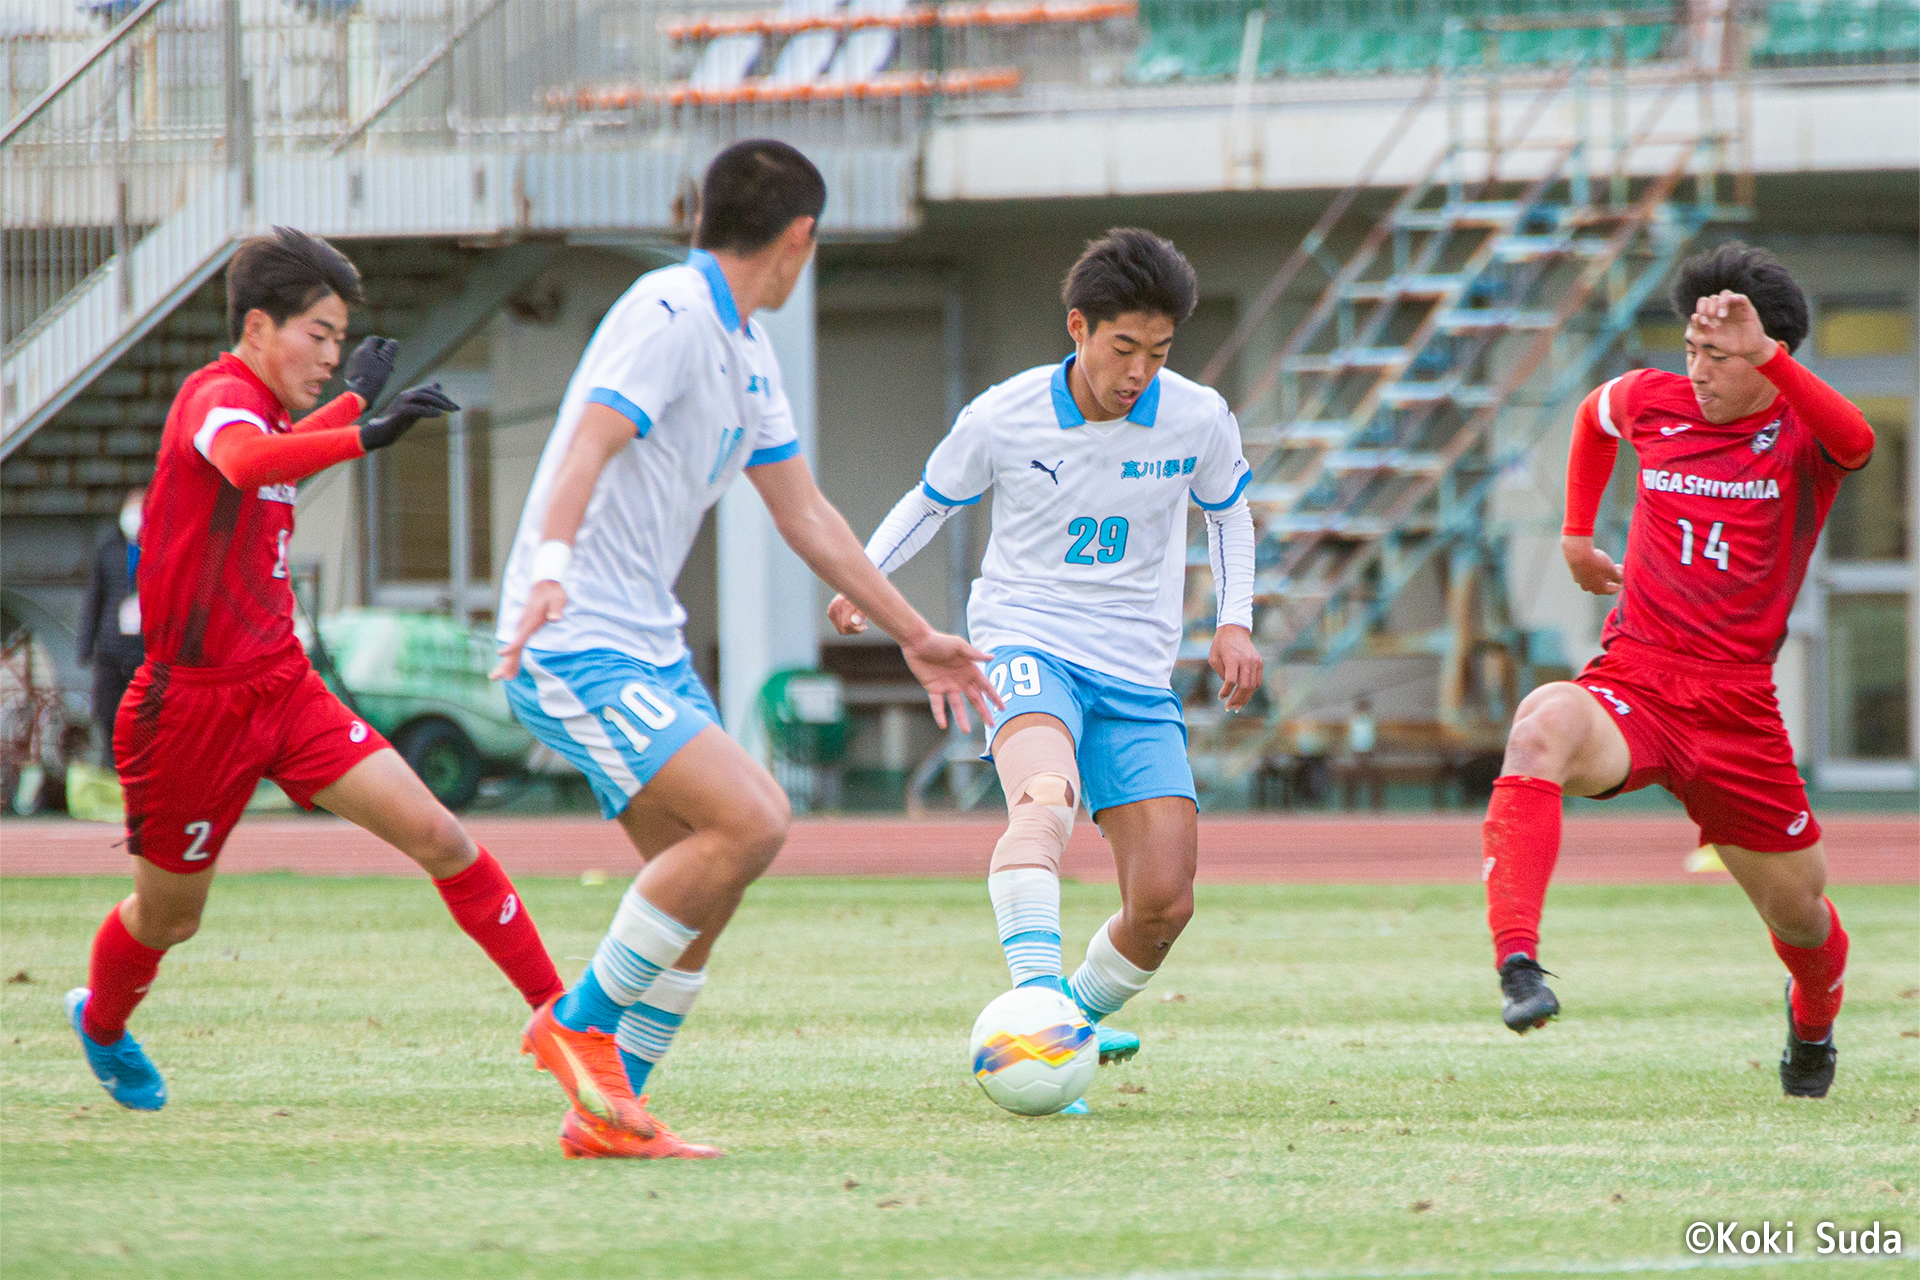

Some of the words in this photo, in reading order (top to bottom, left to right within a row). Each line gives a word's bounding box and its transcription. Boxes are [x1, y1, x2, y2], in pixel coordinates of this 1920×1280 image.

[1064, 516, 1129, 565] 29
[1677, 517, 1729, 571] 14
[989, 655, 1041, 713] 29
[601, 683, 676, 754] 10
[182, 820, 211, 861] 2
